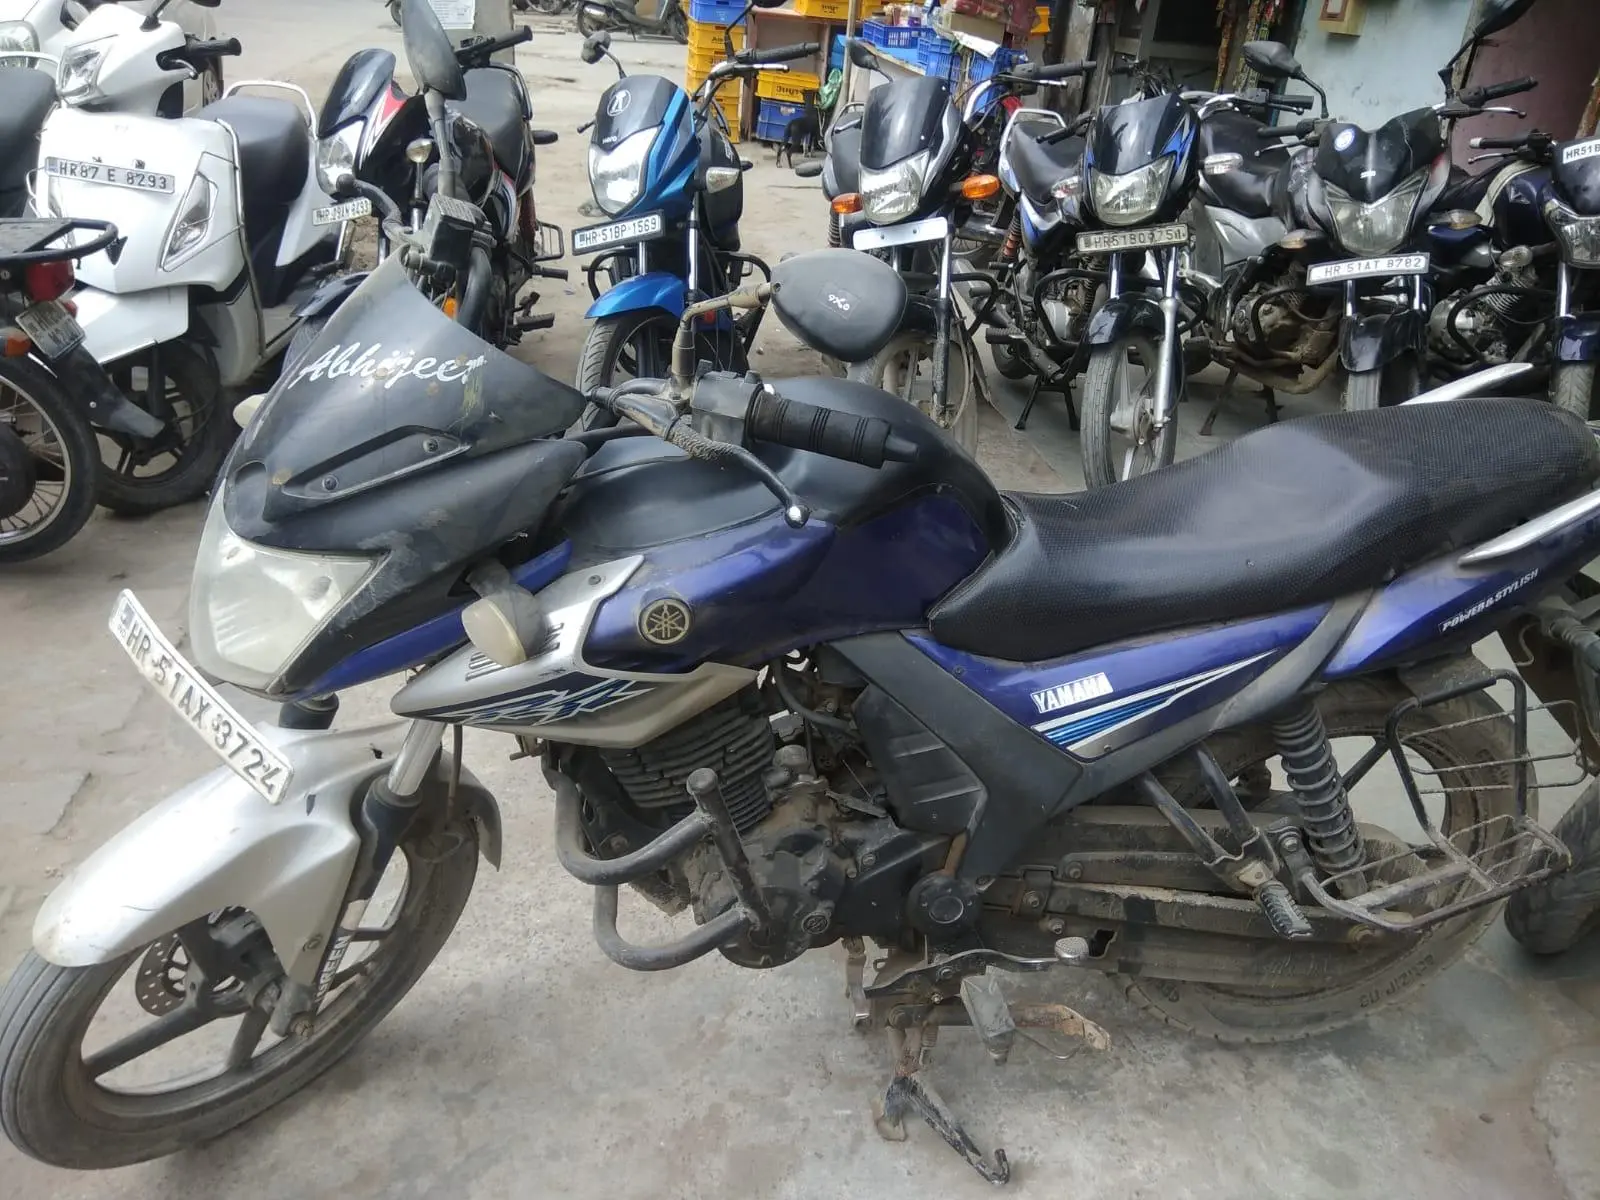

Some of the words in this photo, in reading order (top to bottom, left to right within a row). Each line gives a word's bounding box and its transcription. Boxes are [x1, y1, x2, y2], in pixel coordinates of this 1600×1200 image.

[59, 161, 100, 180] HR87
[107, 168, 117, 183] E
[126, 171, 168, 190] 8293
[1032, 673, 1113, 712] YAMAHA
